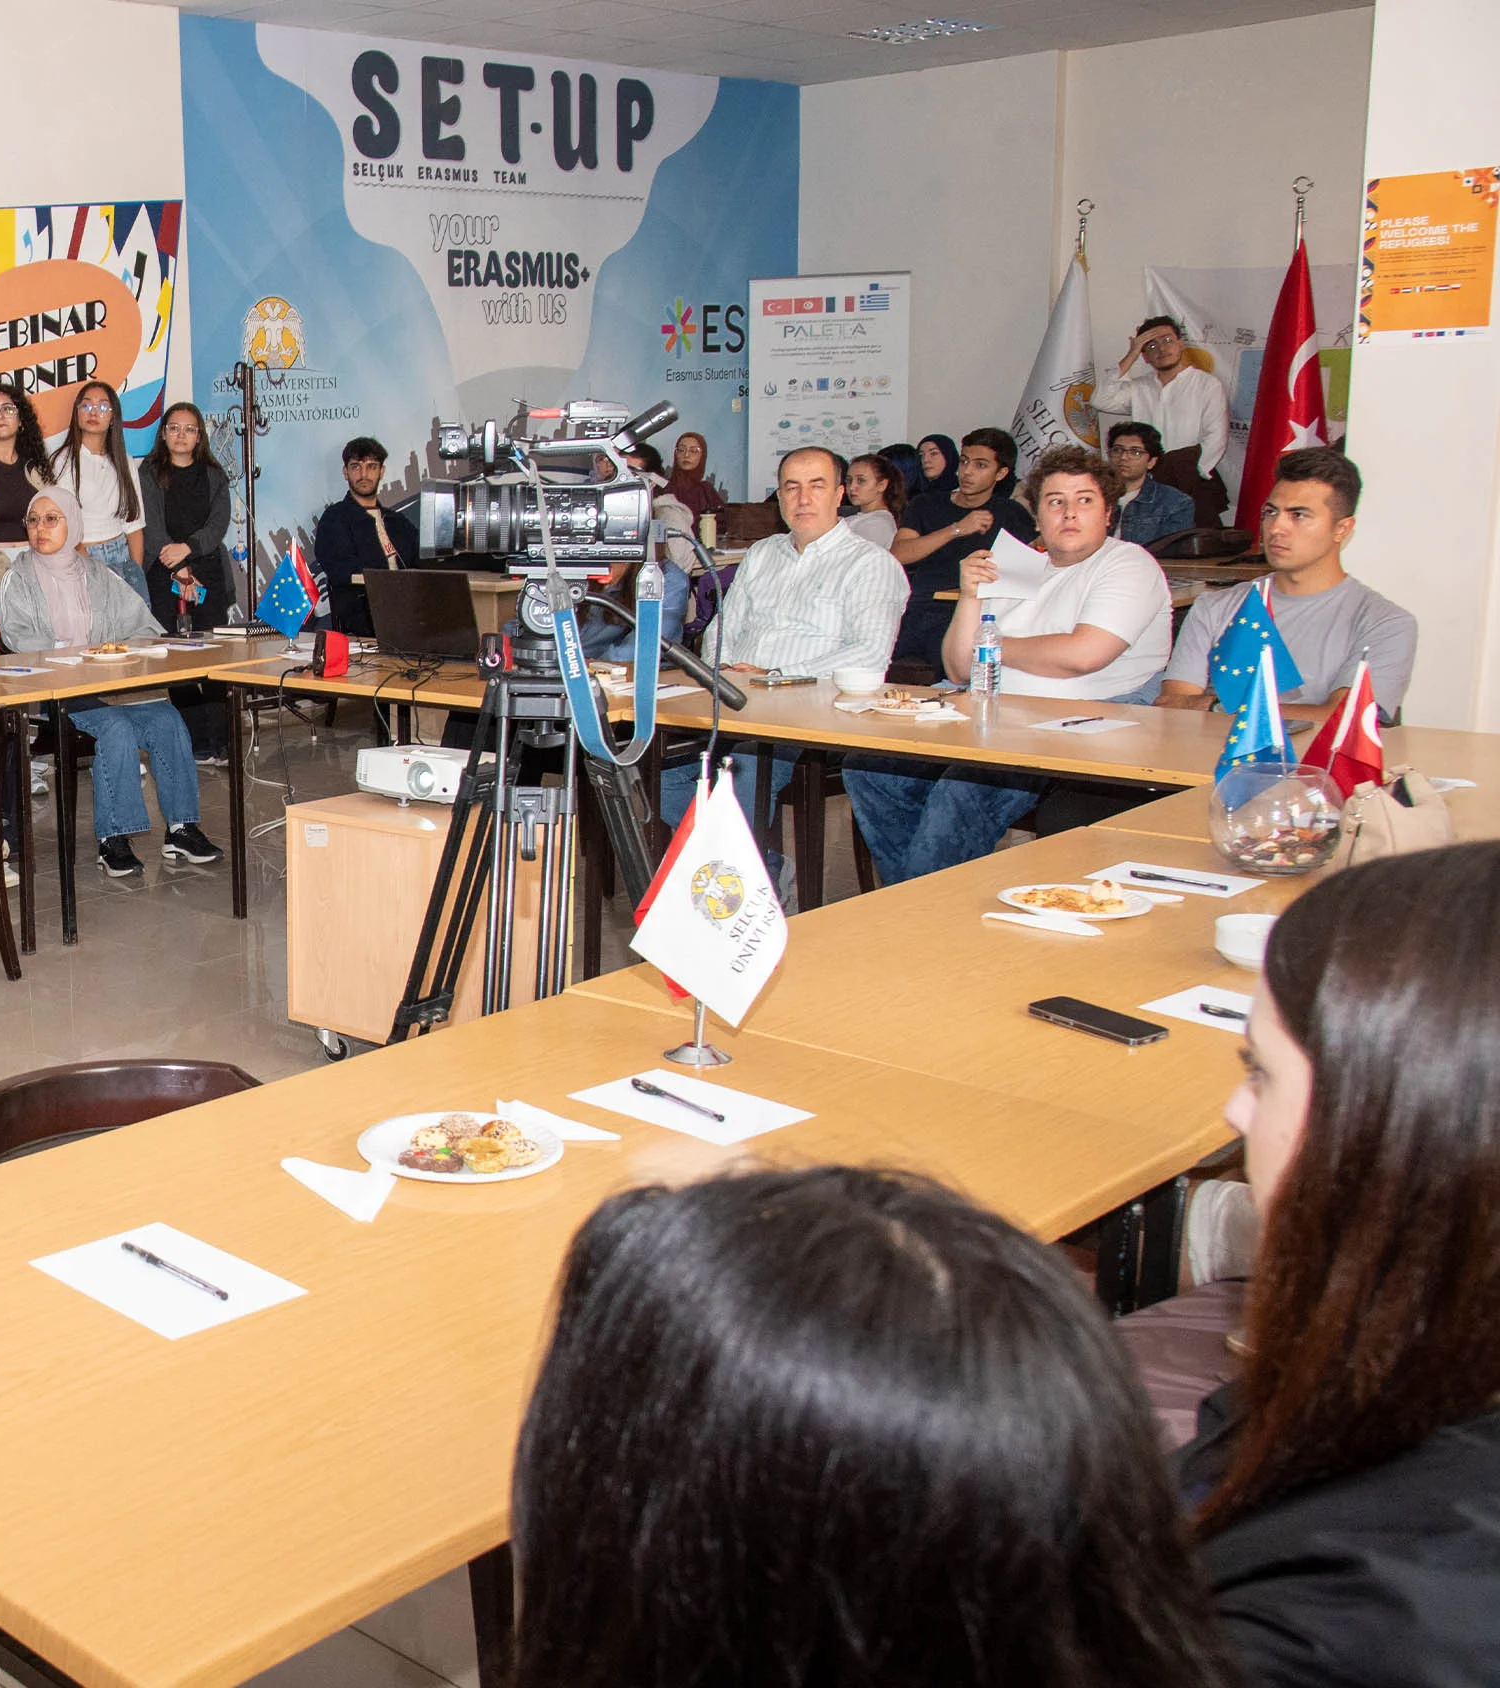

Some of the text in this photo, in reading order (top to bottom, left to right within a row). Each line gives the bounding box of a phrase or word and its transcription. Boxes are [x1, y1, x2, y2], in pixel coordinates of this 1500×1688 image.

[353, 163, 527, 185] SELÇUK ERASMUS TEAM
[429, 213, 500, 252] your
[1380, 216, 1429, 228] PLEASE
[1380, 222, 1479, 239] WELCOME THE
[1379, 236, 1451, 249] REFUGEES!
[448, 249, 591, 289] ERASMUS+
[482, 292, 533, 325] with
[666, 369, 703, 382] Erasmus
[705, 368, 736, 380] Student
[562, 620, 582, 679] Handycam
